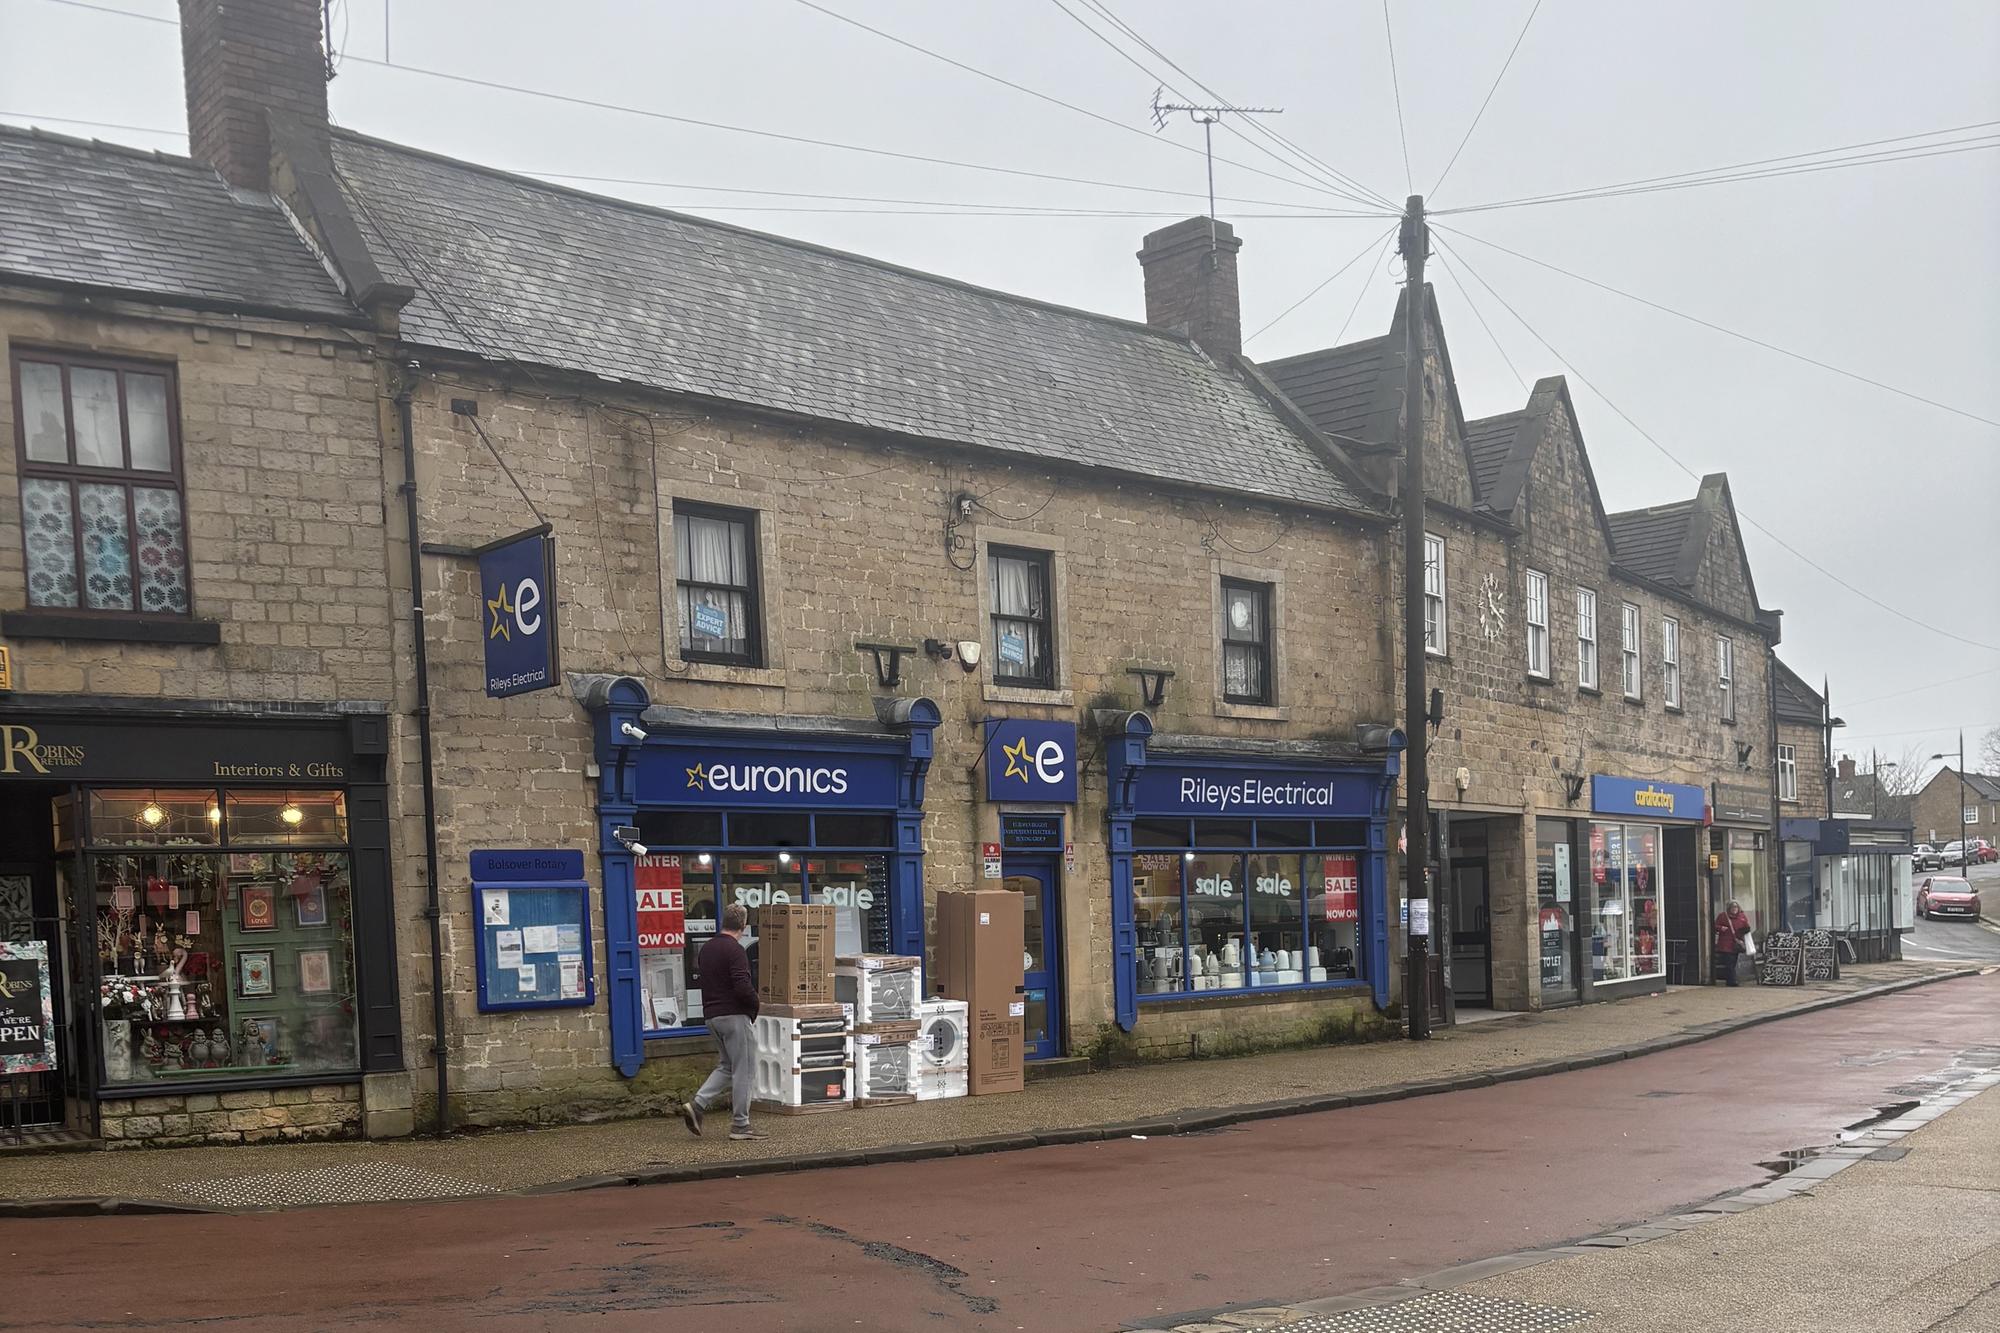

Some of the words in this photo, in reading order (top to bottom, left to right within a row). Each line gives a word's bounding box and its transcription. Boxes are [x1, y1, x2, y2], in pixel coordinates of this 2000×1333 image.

[696, 620, 722, 635] ADVICE
[697, 612, 724, 627] EXPERT
[490, 677, 512, 691] Rileys
[512, 667, 546, 686] Electrical
[0, 724, 85, 773] ROBINS
[40, 757, 82, 767] RETURN
[213, 761, 284, 777] Interiors
[288, 763, 301, 777] &
[306, 762, 344, 777] Gifts
[708, 764, 848, 794] euronics
[1635, 785, 1674, 814] cardfactory
[488, 859, 531, 870] Bolsover
[535, 858, 568, 871] Rotary
[634, 853, 680, 867] INTER
[1142, 854, 1169, 863] SALE
[1195, 873, 1233, 898] sale
[1255, 872, 1292, 897] sale
[1326, 879, 1357, 892] SALE
[637, 892, 683, 909] ALE
[735, 882, 790, 908] sale
[822, 880, 874, 910] sale
[1326, 909, 1345, 920] NOW
[1346, 908, 1358, 918] ON
[638, 933, 661, 946] OW
[664, 932, 685, 944] ON
[1542, 956, 1551, 968] TO
[1551, 955, 1561, 967] LET
[0, 1025, 40, 1043] PEN
